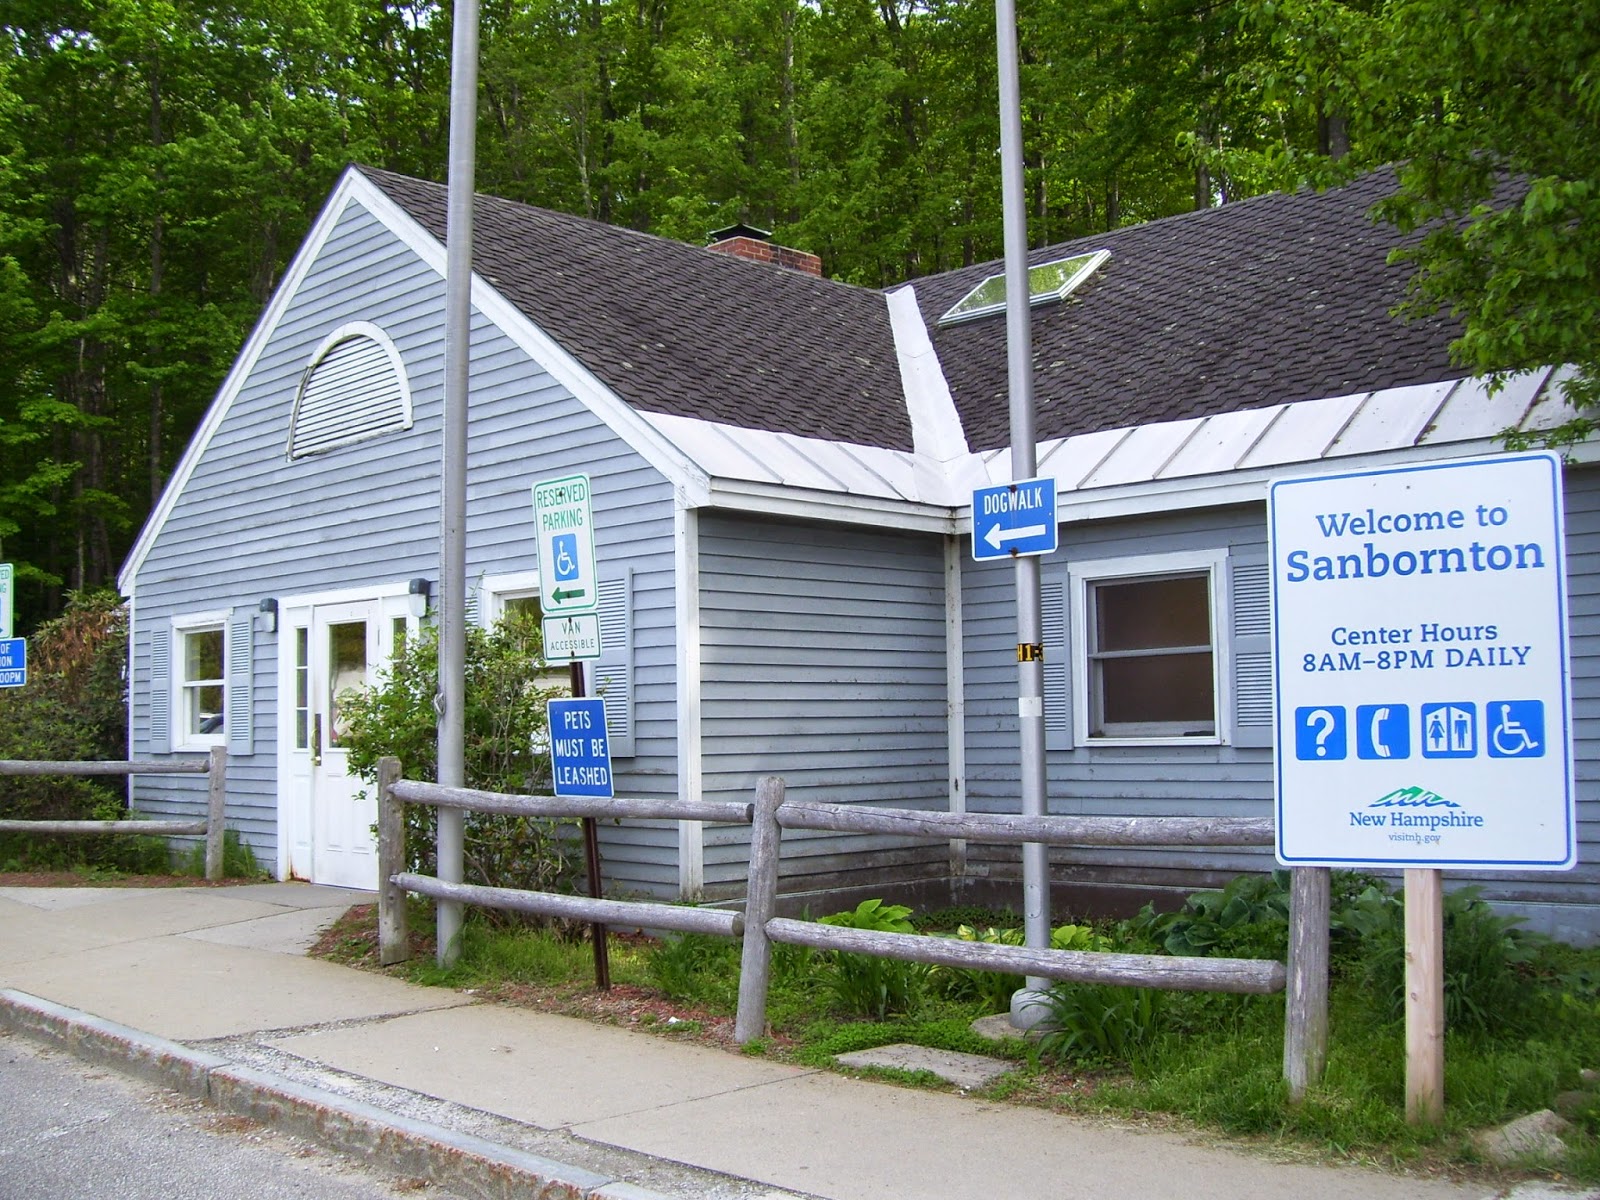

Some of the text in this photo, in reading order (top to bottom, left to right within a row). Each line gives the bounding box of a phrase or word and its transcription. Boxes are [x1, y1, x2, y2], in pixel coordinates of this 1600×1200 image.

[537, 483, 585, 509] RESERVED
[983, 487, 1043, 515] DOGWALK
[542, 508, 583, 531] PARKING
[1316, 504, 1508, 537] Welcome to
[1287, 542, 1545, 582] Sanbornton
[562, 621, 581, 634] VAN
[1331, 624, 1498, 645] Center Hours
[1, 643, 11, 654] OF
[551, 639, 595, 651] ACCESSIBLE
[1445, 646, 1531, 667] DAILY
[564, 710, 591, 729] PETS
[555, 738, 606, 757] MUST BE
[557, 766, 608, 785] LEASHED
[1349, 811, 1484, 831] New Hampshire
[1388, 833, 1441, 843] visitnh.gov
